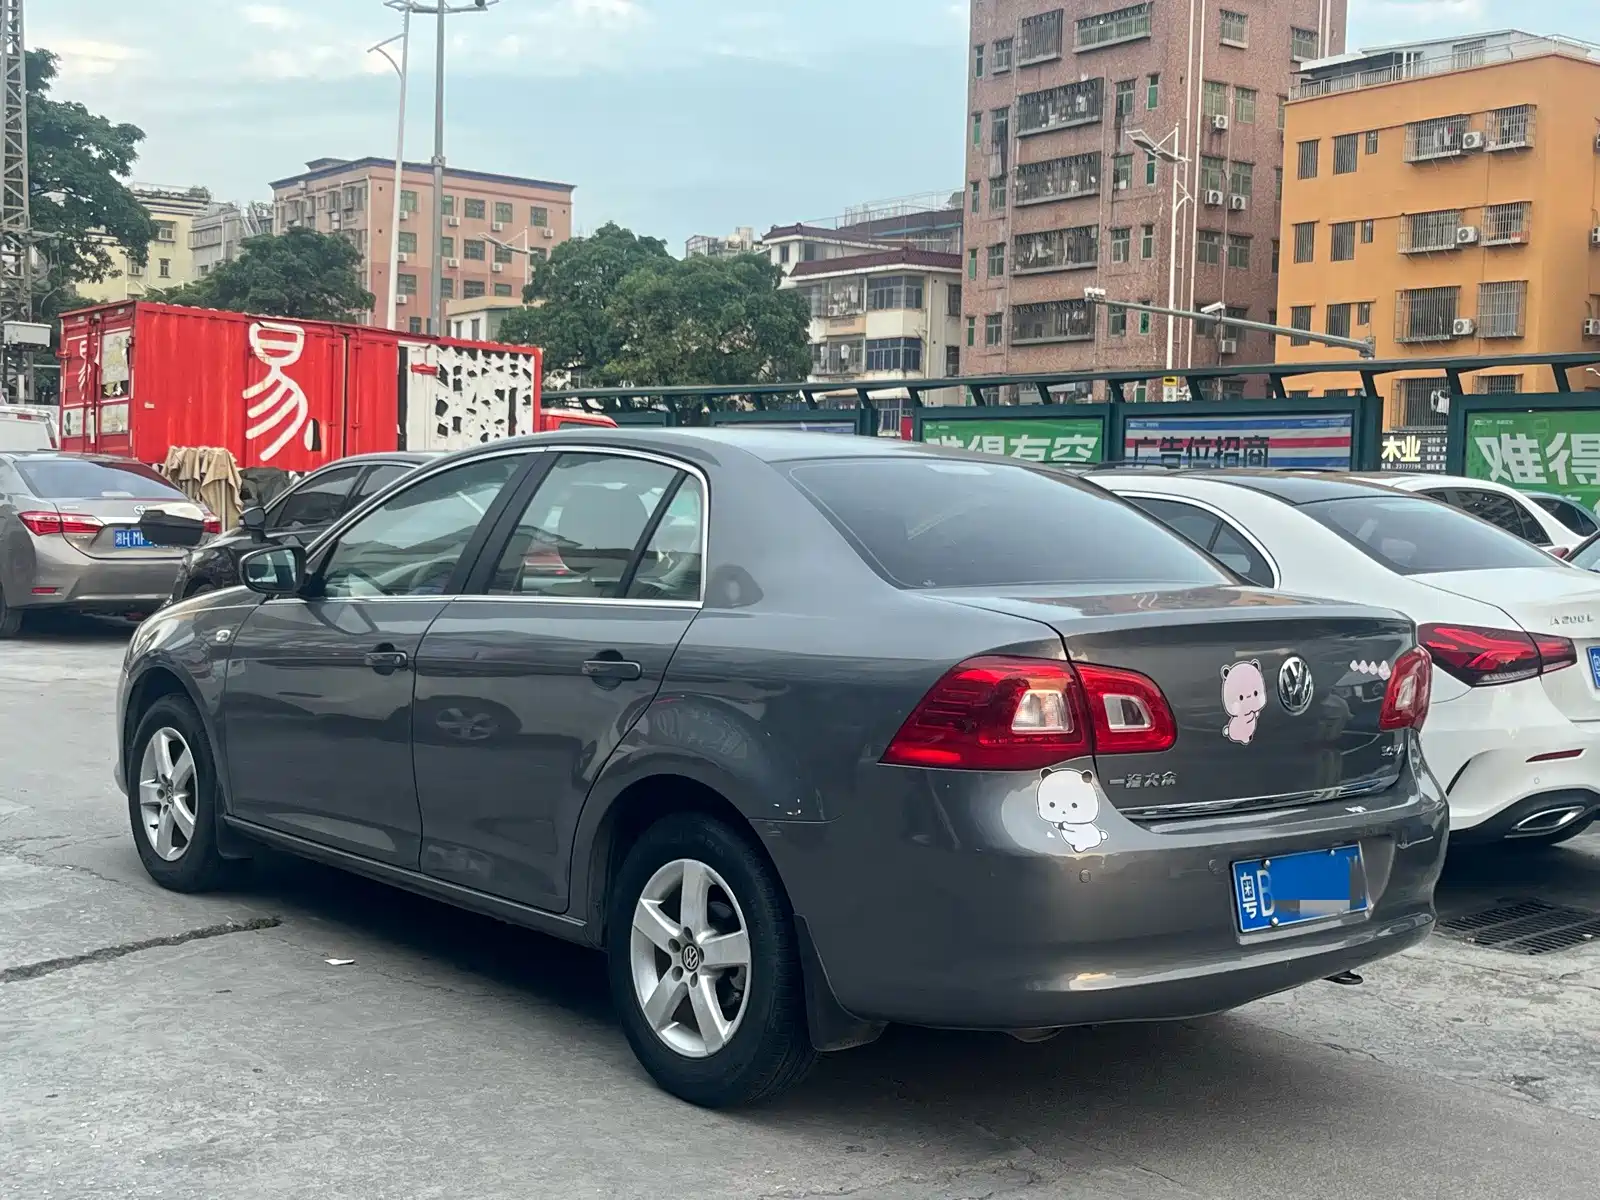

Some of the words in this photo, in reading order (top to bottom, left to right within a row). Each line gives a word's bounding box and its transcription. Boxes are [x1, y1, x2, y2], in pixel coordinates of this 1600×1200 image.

[1134, 435, 1270, 468] 广告位招商
[1381, 435, 1421, 462] 木业
[1474, 432, 1600, 485] 难得
